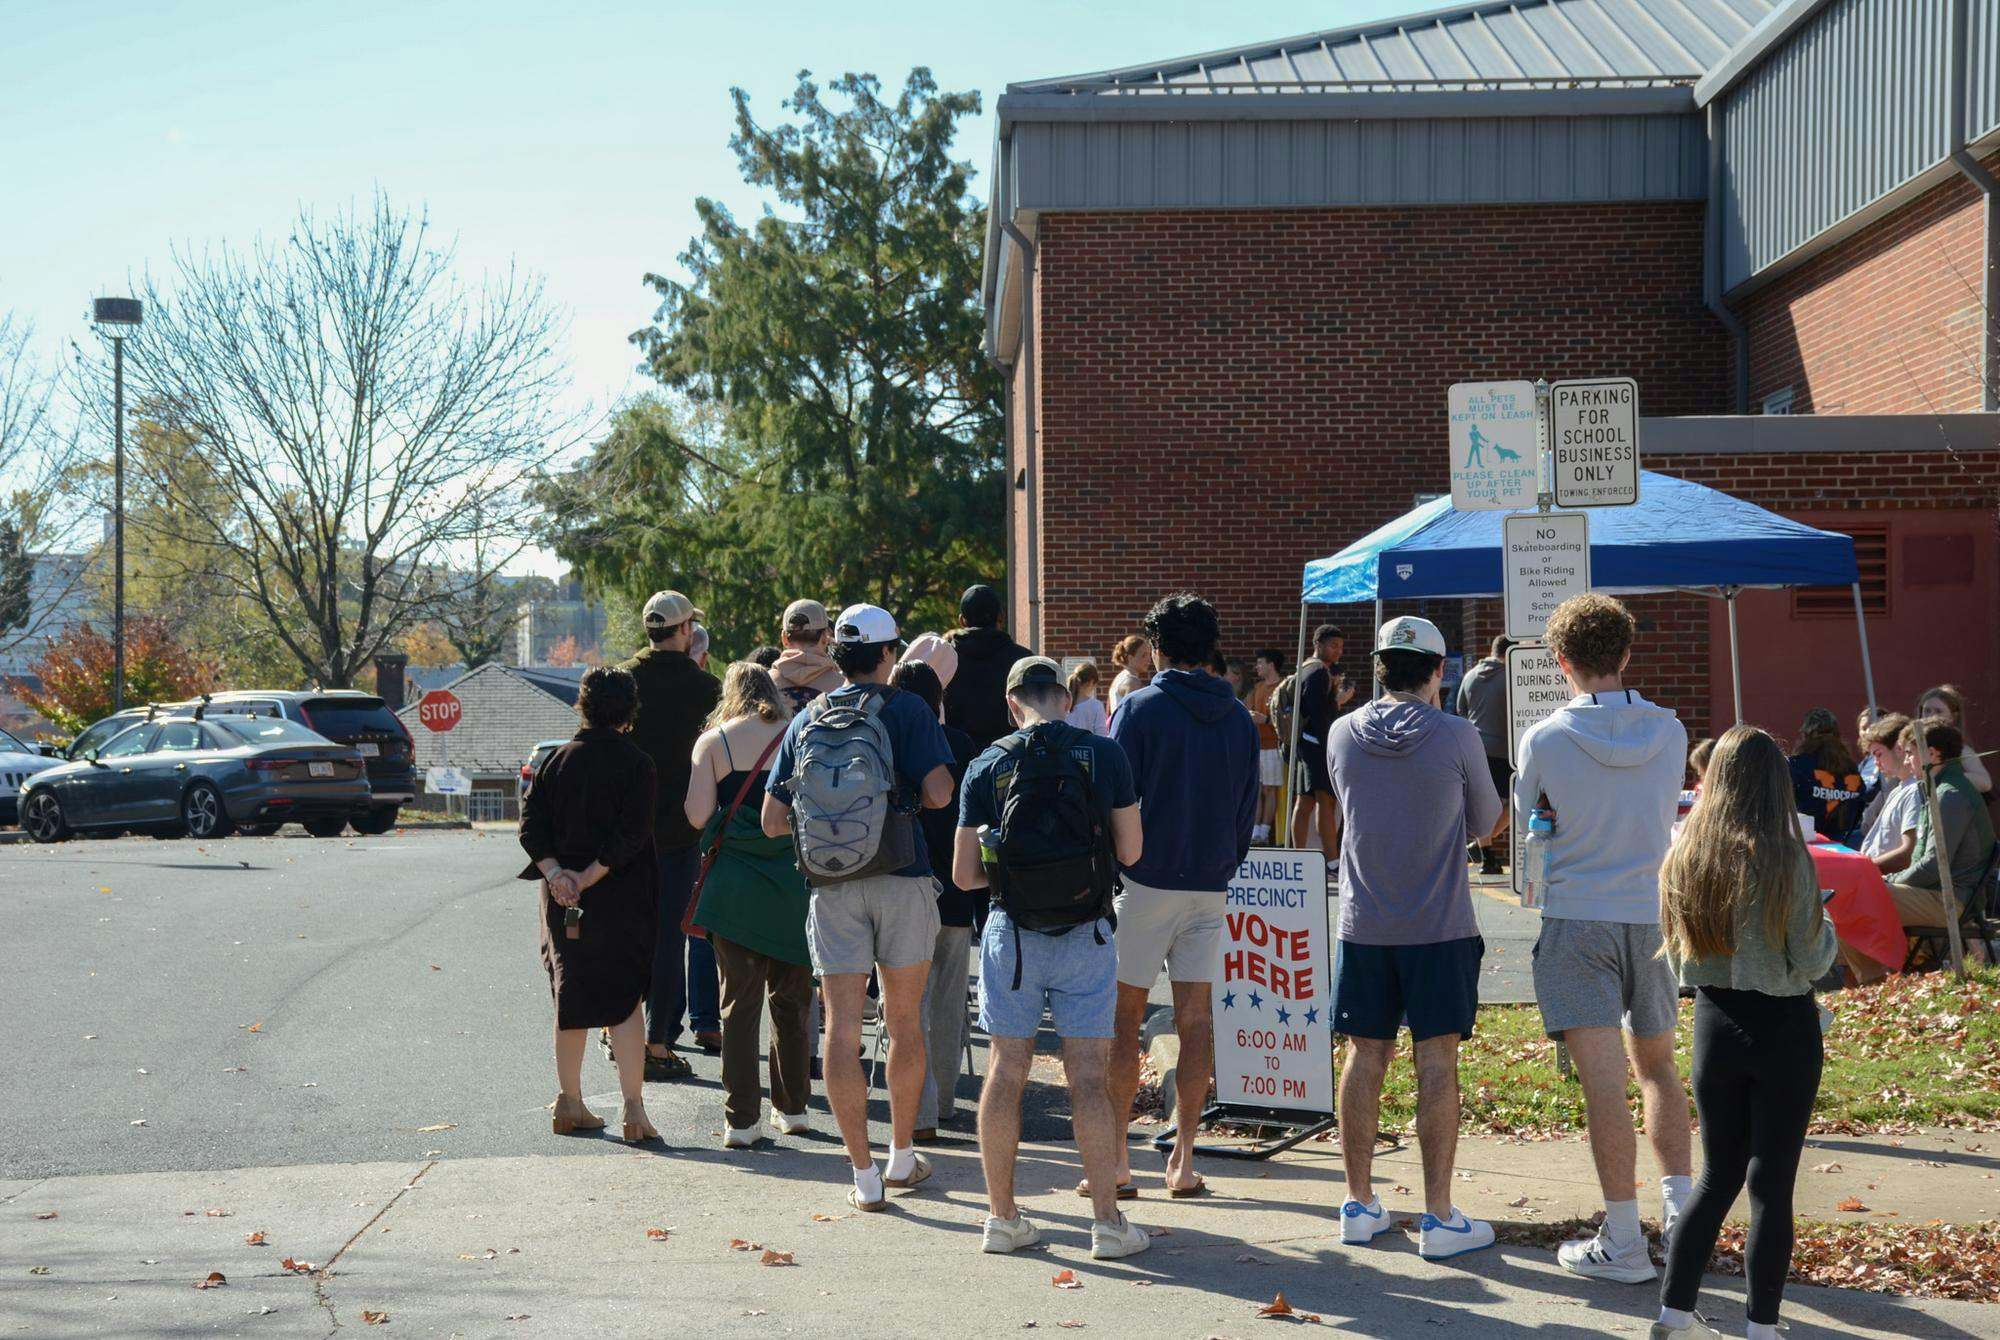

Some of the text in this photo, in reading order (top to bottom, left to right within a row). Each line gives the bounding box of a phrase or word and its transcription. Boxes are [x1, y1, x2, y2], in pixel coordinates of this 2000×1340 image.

[1468, 394, 1516, 404] ALL PETS
[1560, 388, 1630, 407] PARKING
[1469, 403, 1515, 412] MUST BE
[1451, 410, 1533, 422] KEPT ON LEASH
[1578, 408, 1609, 425] FOR
[1563, 427, 1626, 445] SCHOOL
[1559, 446, 1632, 464] BUSINESS
[1453, 469, 1536, 480] PLEASE CLEAN
[1574, 465, 1614, 482] ONLY
[1467, 479, 1521, 489] UP AFTER
[1467, 487, 1522, 498] YOUR PET
[1559, 486, 1634, 498] TOWING ENFORCED
[1536, 528, 1556, 540] NO
[1511, 543, 1582, 553] Skateboarding
[1541, 556, 1552, 564] or
[1520, 566, 1575, 576] Bike Riding
[1528, 578, 1567, 587] Allowed
[1541, 591, 1554, 599] on
[1531, 601, 1559, 611] Scho
[1528, 614, 1551, 624] Prop
[1521, 658, 1561, 670] NO PARK
[1517, 674, 1567, 687] DURING SN
[1529, 690, 1572, 702] REMOVAL
[421, 702, 459, 720] STOP
[1516, 709, 1556, 718] VIOLATO
[1516, 720, 1527, 728] BE
[1240, 861, 1304, 881] ENABLE
[1226, 887, 1308, 908] PRECINCT
[1226, 912, 1310, 962] VOTE
[1224, 950, 1314, 1000] HERE
[1237, 1029, 1307, 1052] 6:00 AM
[1264, 1056, 1280, 1070] TO
[1241, 1075, 1306, 1099] 7:00 PM
